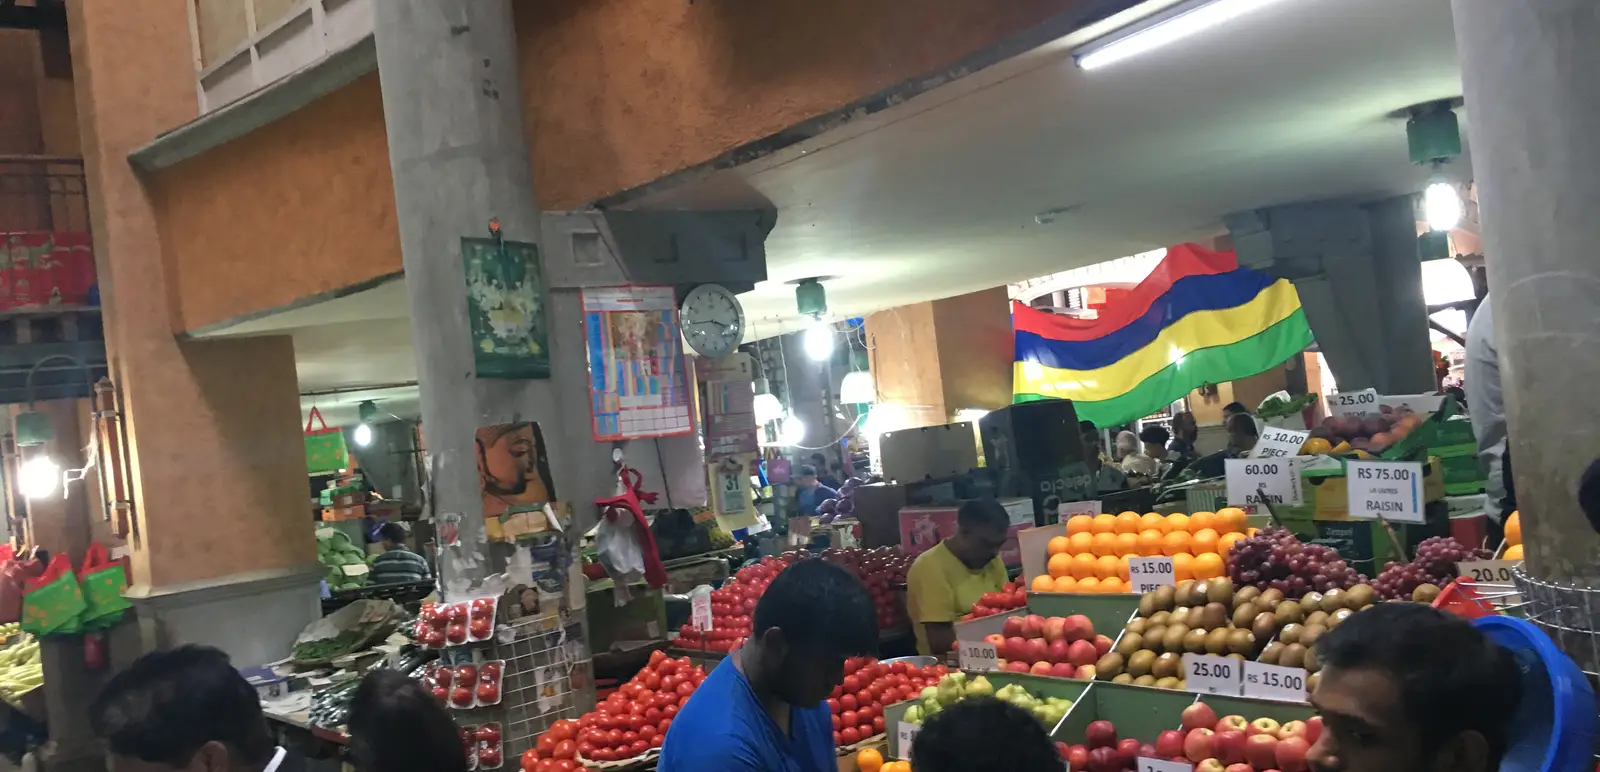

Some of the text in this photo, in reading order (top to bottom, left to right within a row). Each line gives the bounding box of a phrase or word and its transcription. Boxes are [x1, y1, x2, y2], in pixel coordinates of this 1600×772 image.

[1339, 393, 1374, 405] 25.00
[1273, 432, 1304, 445] 10.00
[1245, 464, 1278, 475] 60.00
[1357, 467, 1409, 480] RS 75.00
[725, 474, 739, 491] 31
[1246, 494, 1283, 505] RASIN
[1366, 500, 1403, 512] RAISIN
[1131, 562, 1172, 574] RS 15.00
[1471, 567, 1511, 582] 20.0
[968, 647, 995, 660] 10.00
[1192, 662, 1231, 679] 25.00
[1247, 671, 1303, 691] RS 15.00
